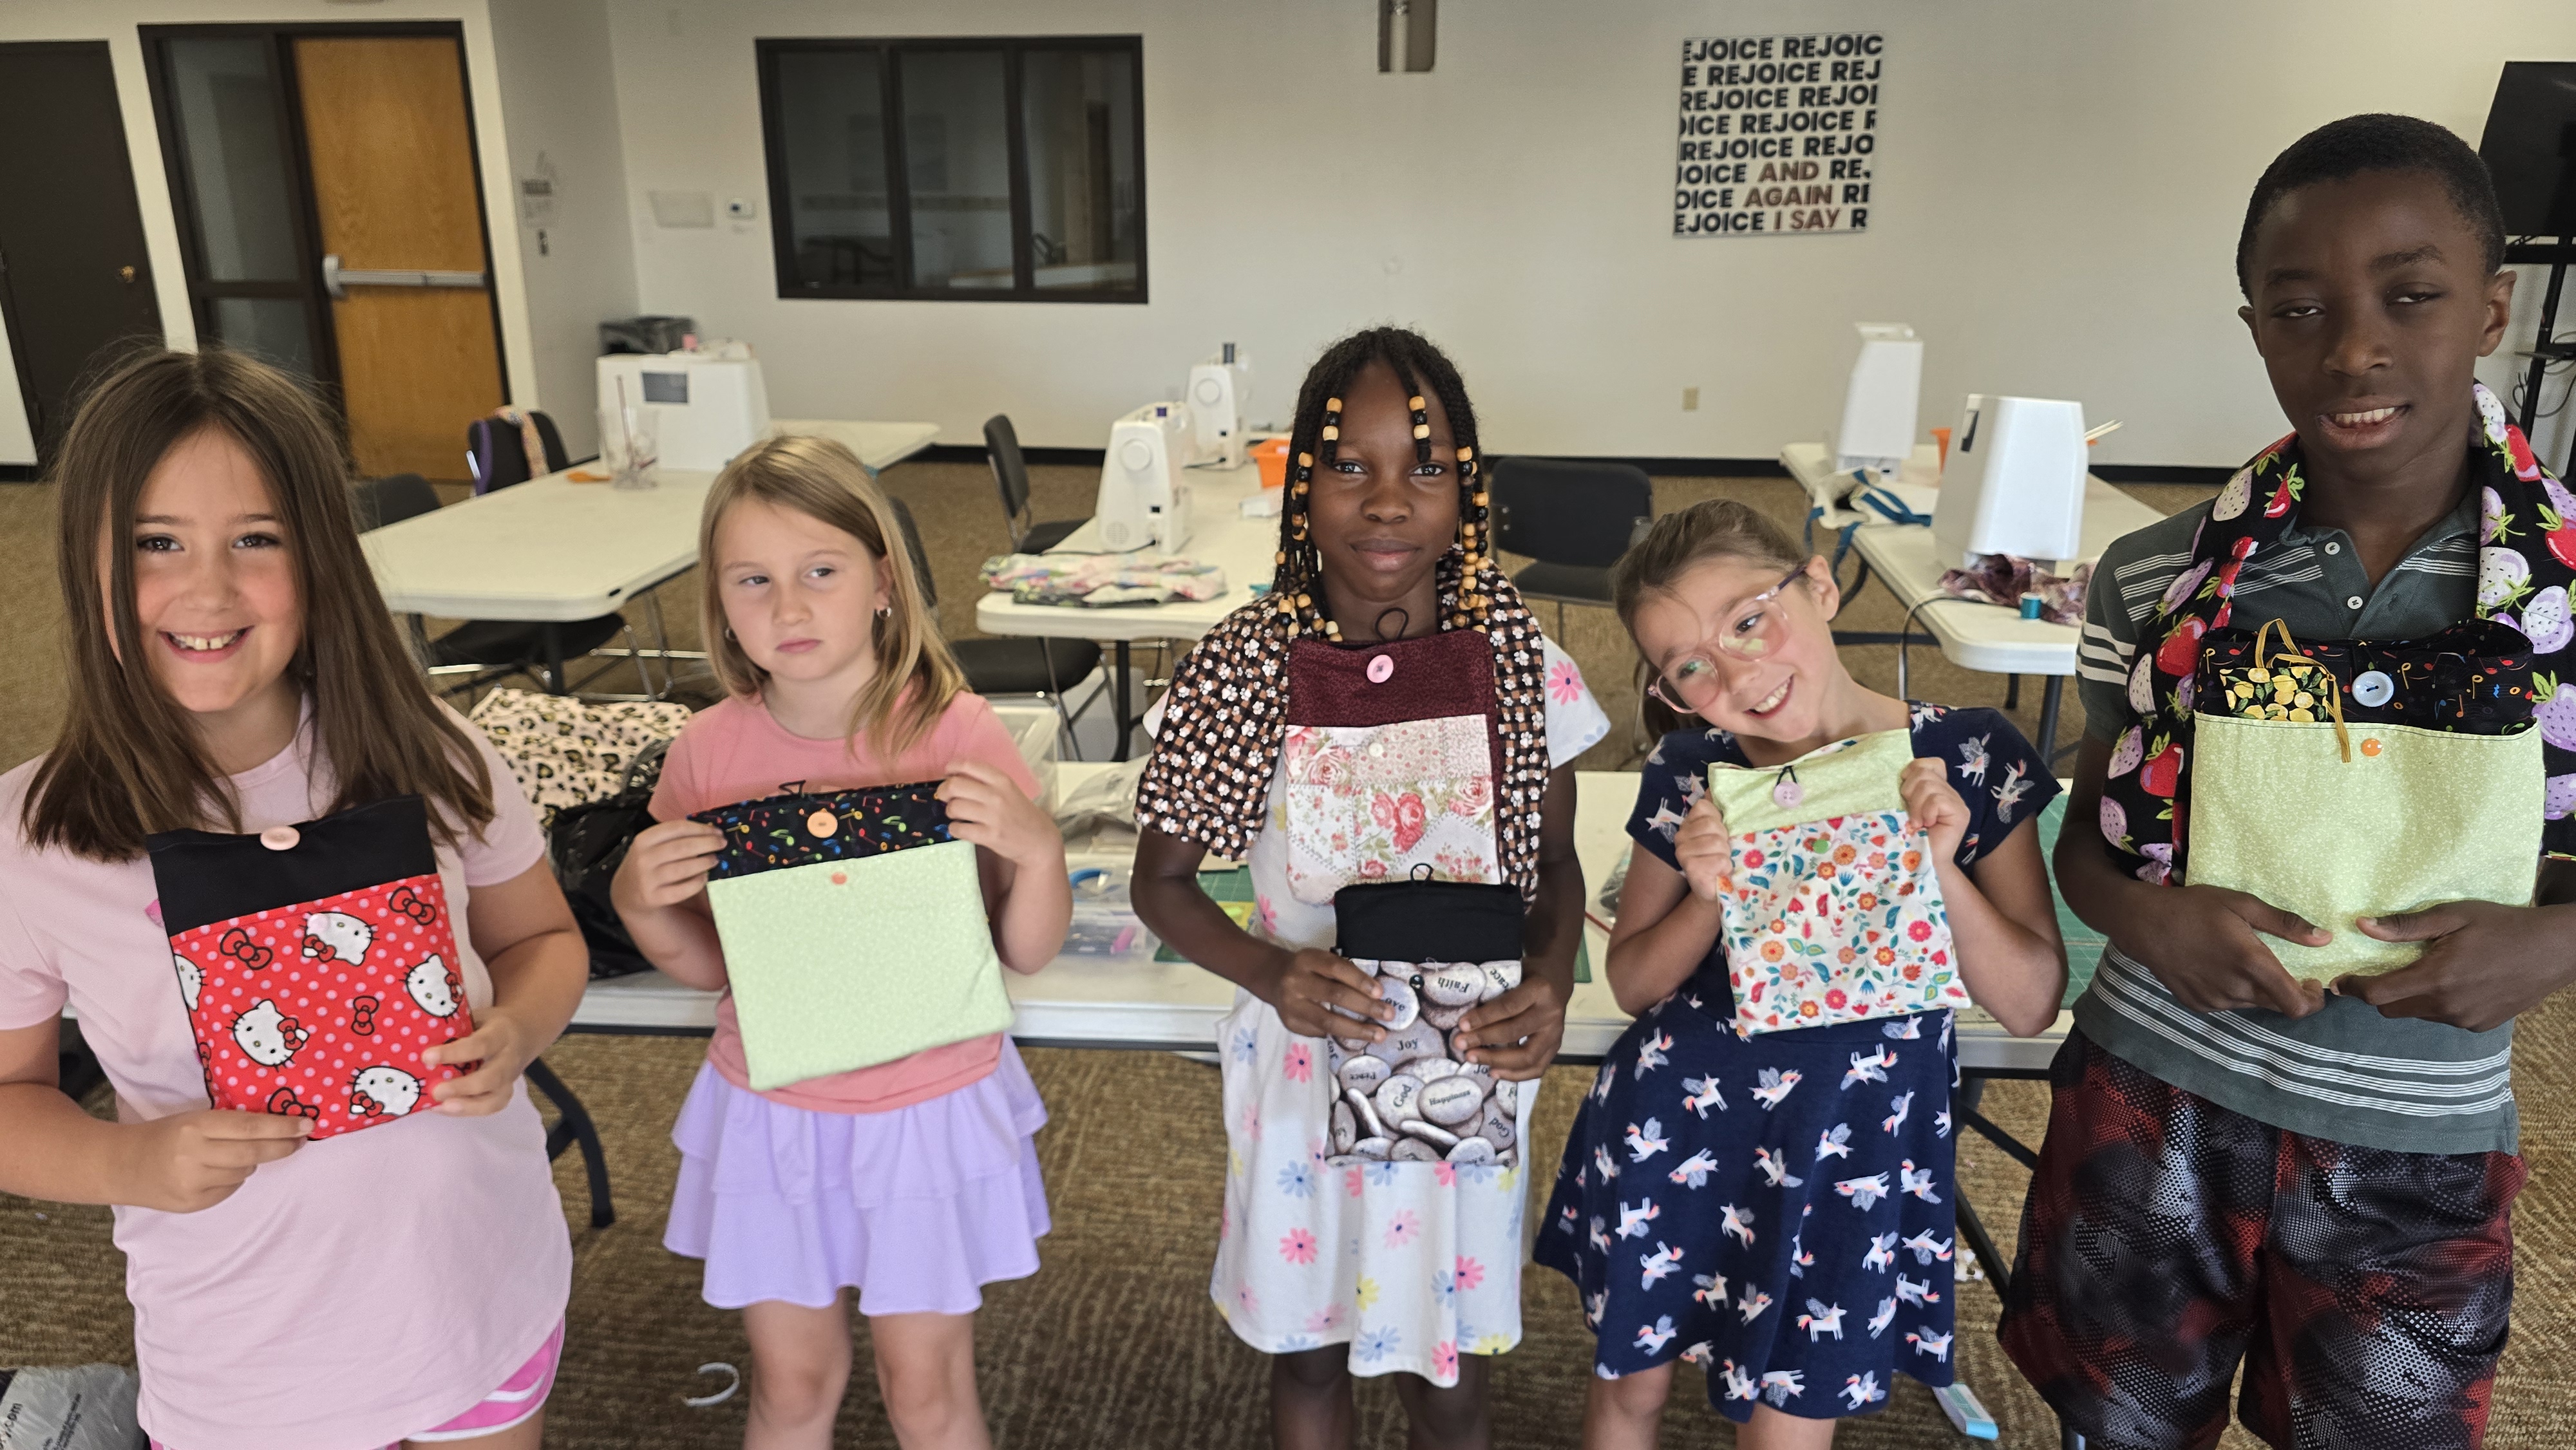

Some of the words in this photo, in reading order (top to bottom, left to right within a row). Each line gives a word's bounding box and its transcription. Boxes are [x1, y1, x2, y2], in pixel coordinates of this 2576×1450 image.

[1782, 34, 1882, 59] REJOIC
[1683, 66, 1698, 86] E
[1707, 62, 1821, 86] REJOICE
[1830, 59, 1880, 81] REJ
[1681, 88, 1788, 111] REJOICE
[1798, 84, 1877, 107] REJOI
[1740, 110, 1854, 135] REJOICE
[1680, 137, 1793, 160] REJOICE
[1803, 133, 1873, 156] REJO
[1757, 161, 1819, 182] AND
[1830, 158, 1871, 179] RE
[1676, 188, 1733, 210] OICE
[1743, 184, 1833, 208] AGAIN
[1675, 211, 1765, 233] EJOICE
[1773, 210, 1782, 230] I
[1789, 207, 1840, 230] SAY
[1850, 208, 1867, 228] R
[1437, 977, 1470, 993] Faith
[1490, 968, 1510, 990] eace
[1384, 997, 1405, 1012] ove
[1397, 1038, 1419, 1051] Joy
[1473, 1064, 1492, 1077] Jo
[1393, 1084, 1412, 1107] God
[1429, 1089, 1471, 1106] Happiness
[1488, 1116, 1510, 1138] God
